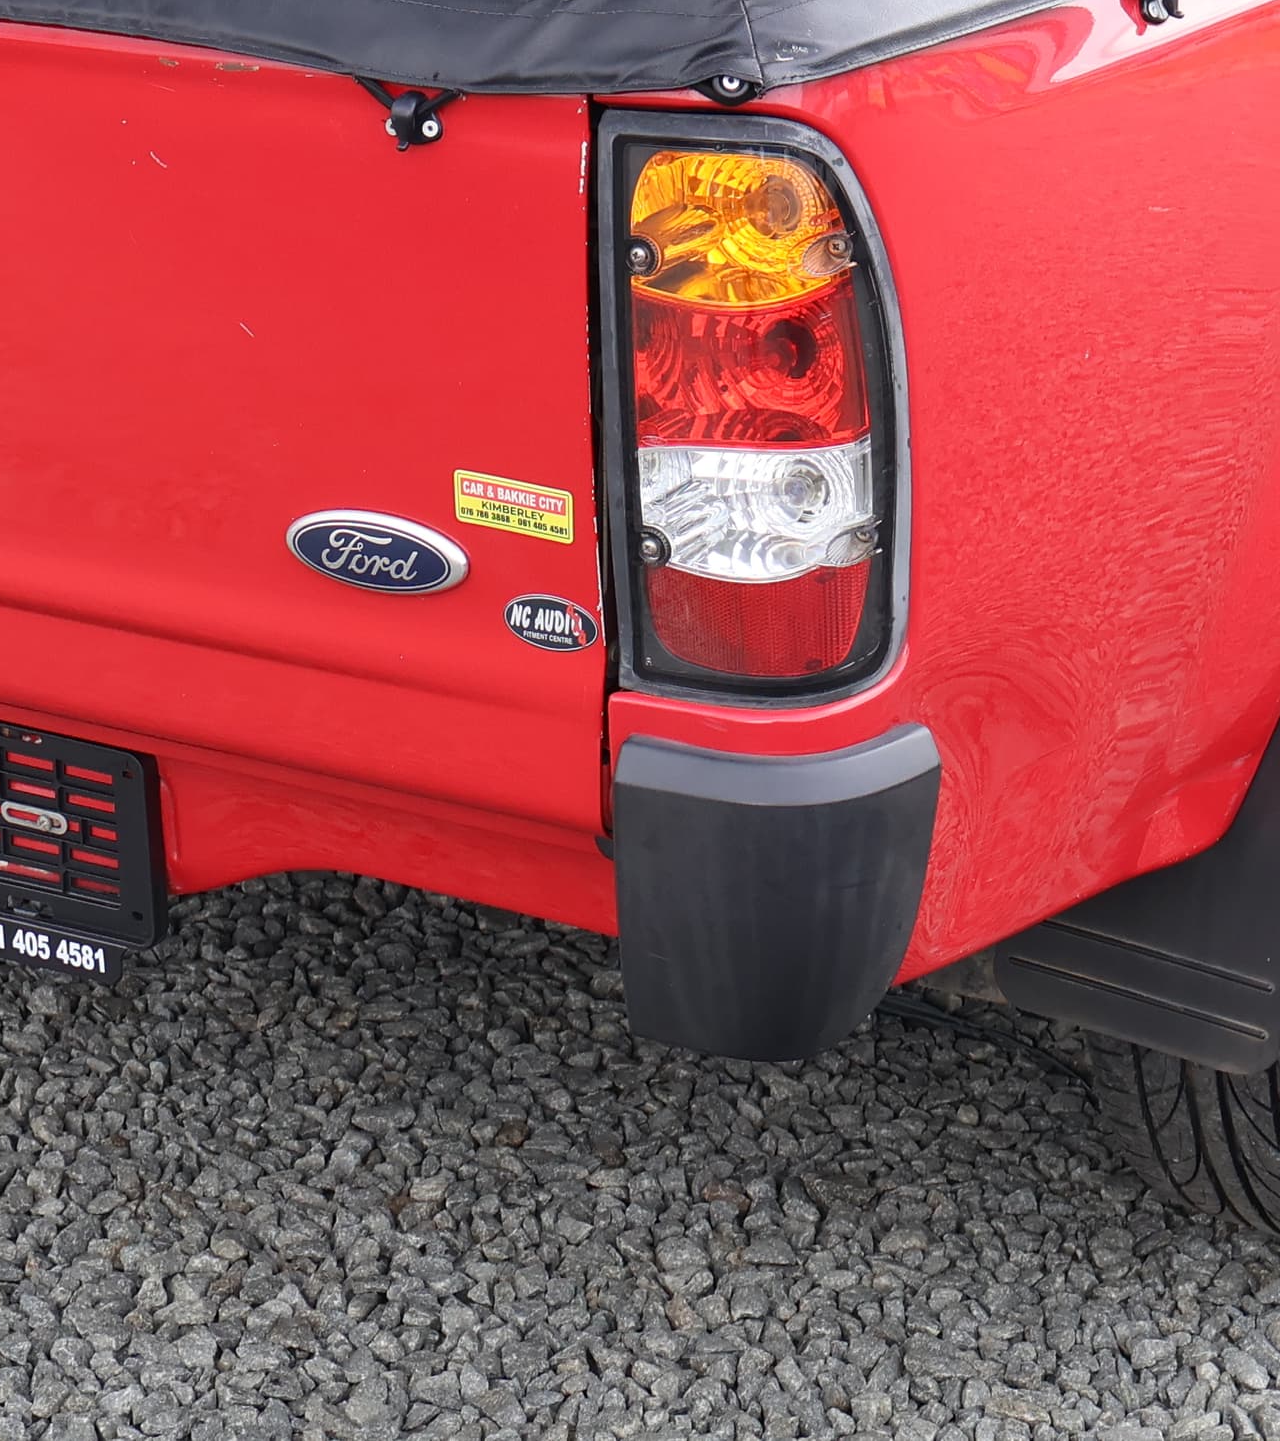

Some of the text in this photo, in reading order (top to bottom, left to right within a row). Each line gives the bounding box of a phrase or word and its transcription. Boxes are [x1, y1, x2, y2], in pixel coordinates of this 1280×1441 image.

[462, 480, 565, 512] CAR & BAKKIE CITY
[481, 500, 545, 521] KIMBERLEY
[320, 527, 419, 582] Ford
[509, 603, 532, 629] NC
[523, 630, 574, 645] FITMENT CENTRE
[11, 928, 51, 959] 405
[56, 939, 106, 973] 4581
